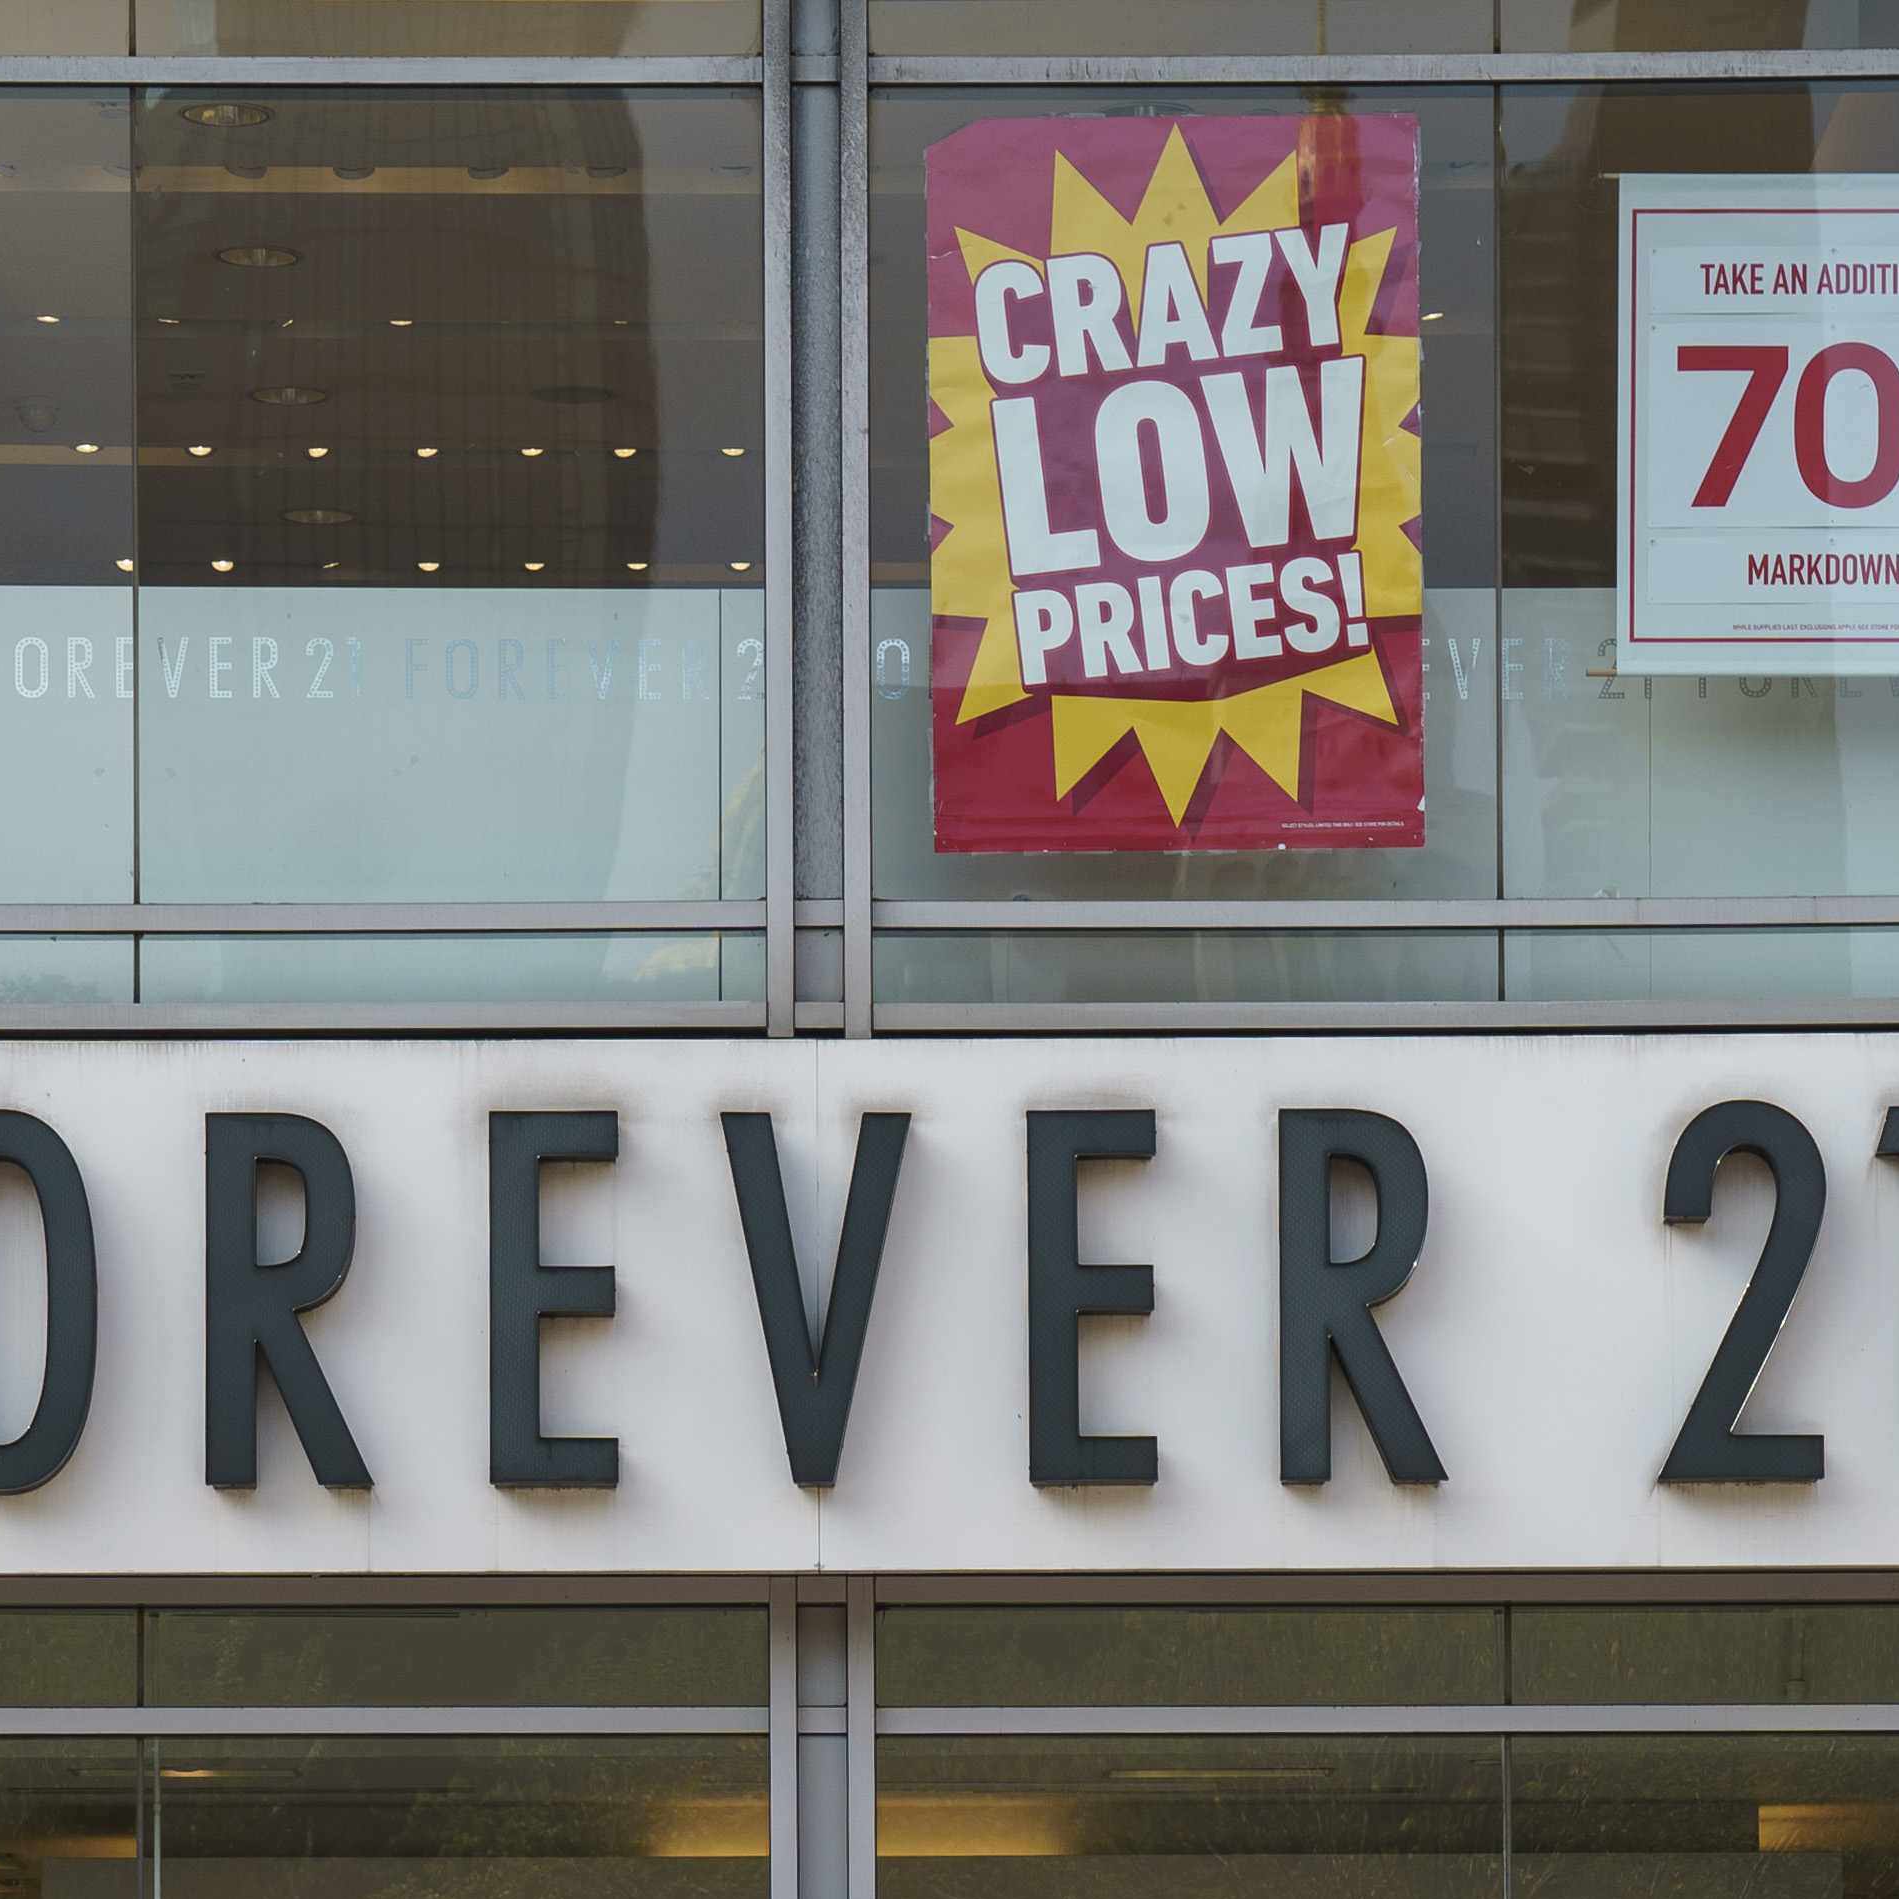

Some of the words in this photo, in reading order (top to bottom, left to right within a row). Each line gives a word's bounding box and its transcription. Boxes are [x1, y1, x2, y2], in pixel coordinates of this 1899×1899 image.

[975, 223, 1349, 384] CRAZY
[1701, 264, 1764, 295] TAKE
[1773, 264, 1807, 295] AN
[992, 355, 1365, 576] LOW
[1012, 551, 1369, 686] PRICES!
